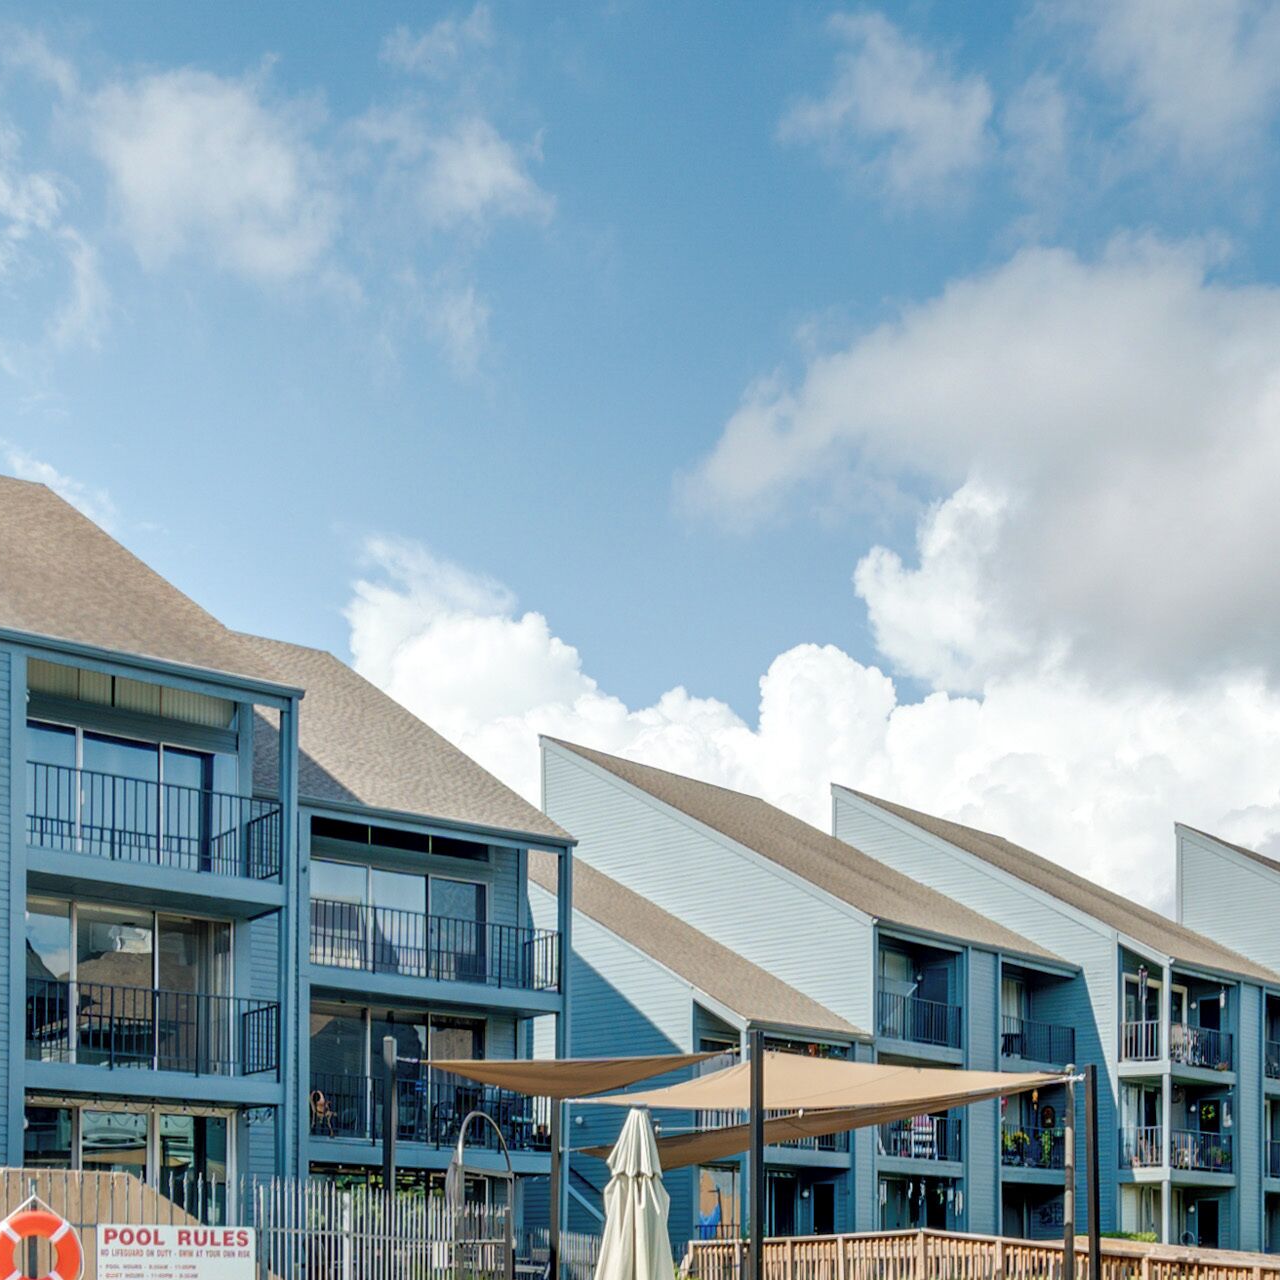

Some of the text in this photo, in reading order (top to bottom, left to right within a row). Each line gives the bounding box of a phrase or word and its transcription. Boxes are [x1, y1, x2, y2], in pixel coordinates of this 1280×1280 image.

[104, 1228, 249, 1247] POOL RULES
[101, 1249, 109, 1257] NO
[111, 1249, 144, 1258] LIFEGUARD
[146, 1249, 155, 1258] ON
[157, 1249, 172, 1258] DUTY
[178, 1250, 194, 1258] SWIM
[196, 1250, 203, 1258] AT
[206, 1250, 221, 1258] YOUR
[223, 1250, 235, 1258] OWN
[238, 1250, 251, 1258] RISK
